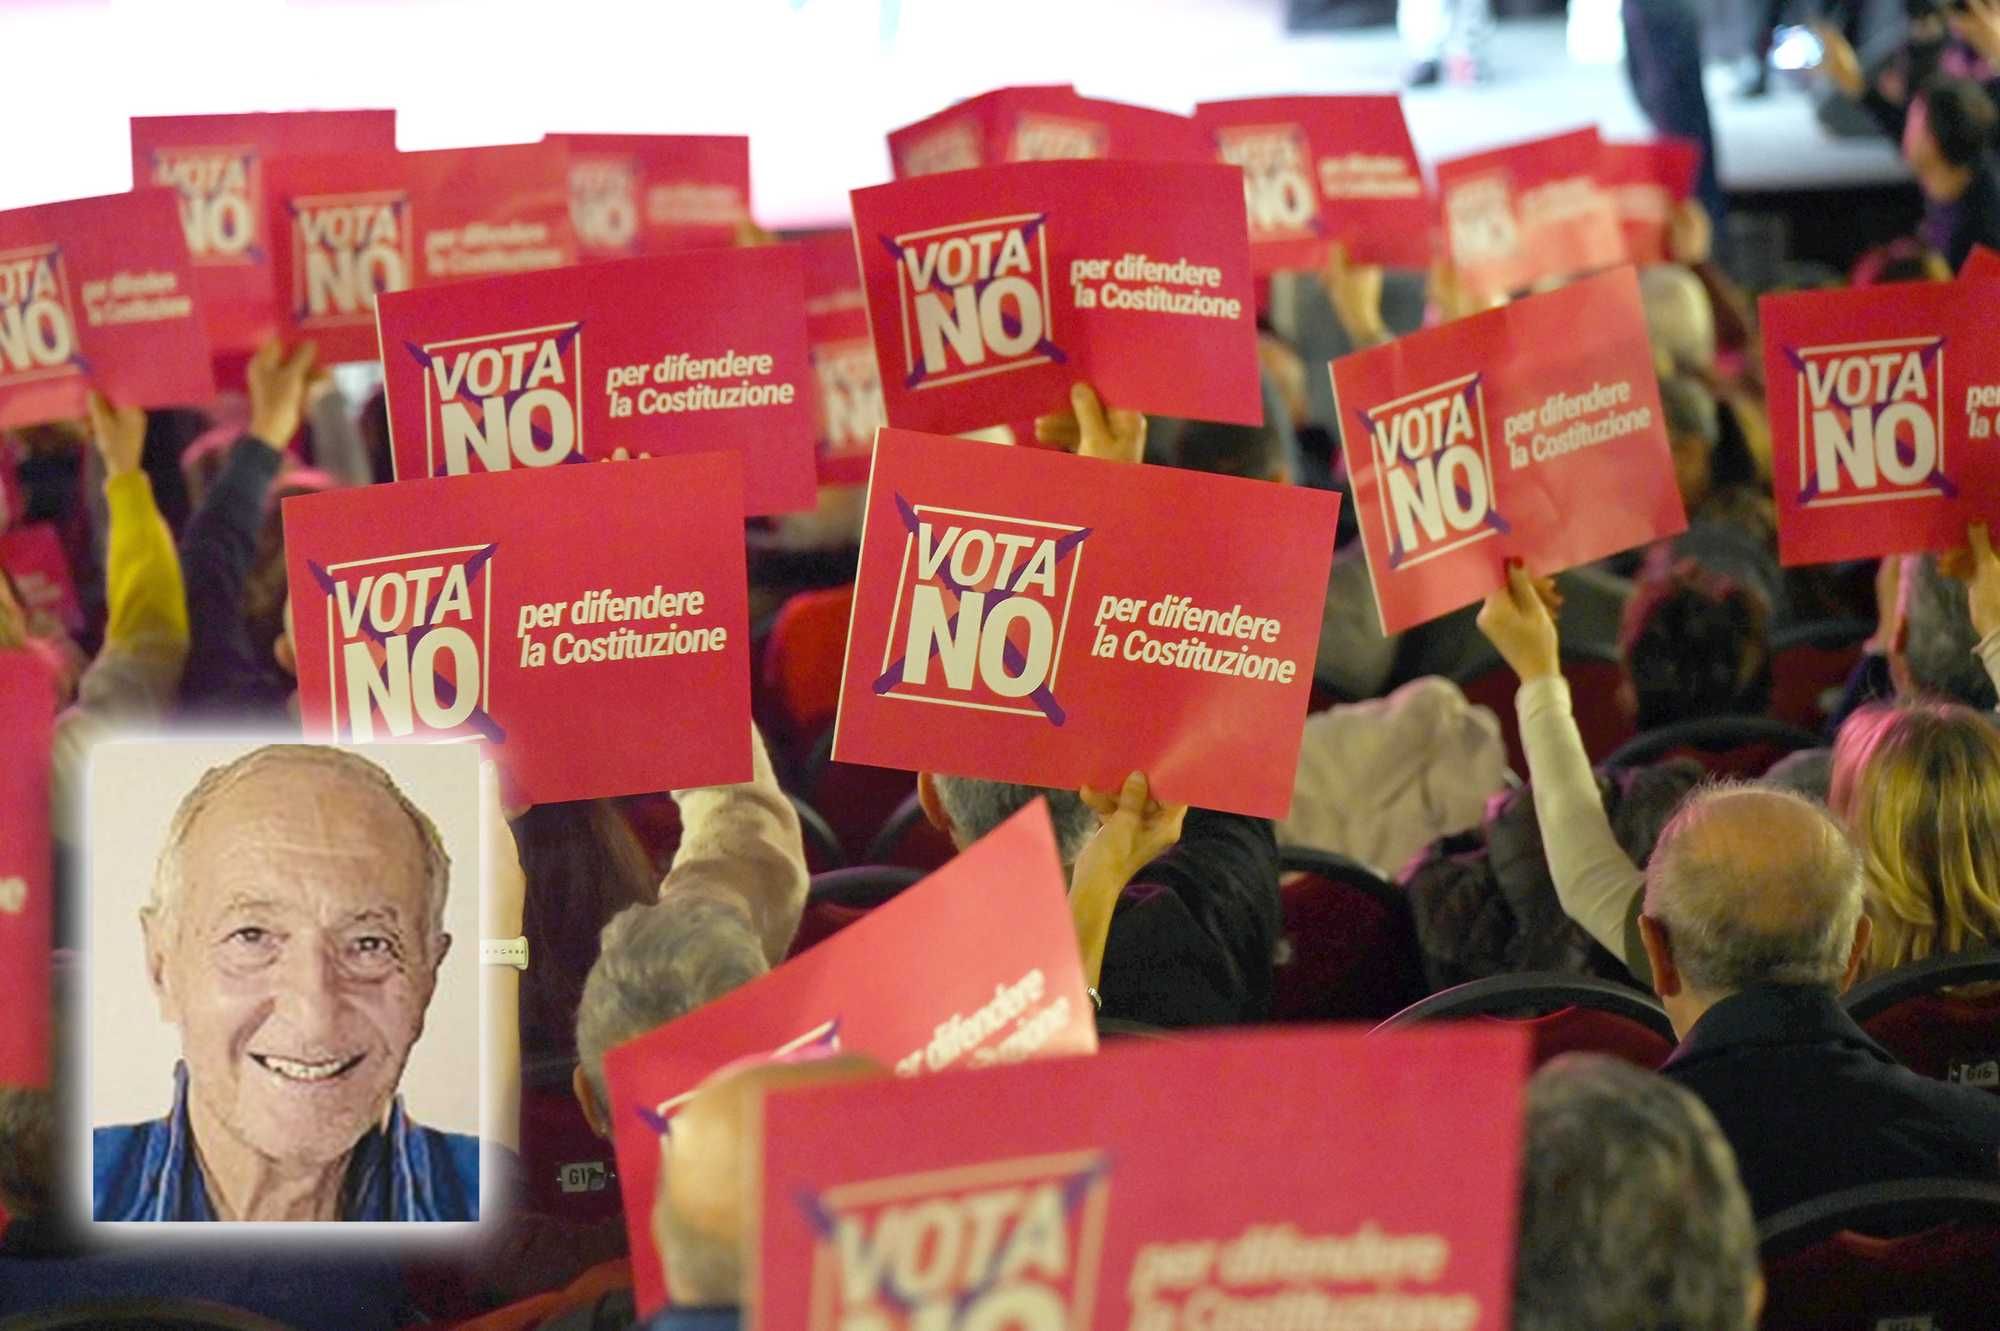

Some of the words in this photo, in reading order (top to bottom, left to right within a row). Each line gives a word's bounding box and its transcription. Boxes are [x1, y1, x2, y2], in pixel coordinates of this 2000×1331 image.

[300, 204, 396, 248] VOTA
[0, 255, 58, 304] OTA
[306, 247, 409, 314] NO
[903, 228, 1032, 292] VOTA
[1070, 258, 1111, 286] per
[1114, 253, 1221, 287] difendere
[915, 276, 1044, 374] NO
[1075, 281, 1097, 308] la
[1100, 282, 1241, 320] Costituzione
[431, 338, 566, 402] VOTA
[605, 362, 650, 394] per
[653, 348, 773, 384] difendere
[609, 390, 632, 418] la
[638, 382, 795, 416] Costituzione
[1805, 351, 1929, 408] VOTA
[439, 388, 576, 477] NO
[1375, 393, 1475, 468] VOTA
[1503, 410, 1538, 445] per
[1540, 380, 1631, 427] difendere
[1508, 441, 1530, 471] la
[1531, 406, 1651, 463] Costituzione
[1812, 401, 1937, 493] NO
[1387, 444, 1489, 553] NO
[917, 522, 1057, 597] VOTA
[334, 563, 473, 639] VOTA
[517, 600, 567, 637] per
[569, 585, 705, 626] difendere
[1095, 593, 1149, 628] per
[1149, 592, 1281, 644] difendere
[520, 633, 546, 669] la
[552, 624, 727, 666] Costituzione
[901, 584, 1055, 698] NO
[1091, 627, 1117, 660] la
[1123, 629, 1297, 684] Costituzione
[343, 626, 480, 744] NO
[836, 1184, 1070, 1310] VOTA
